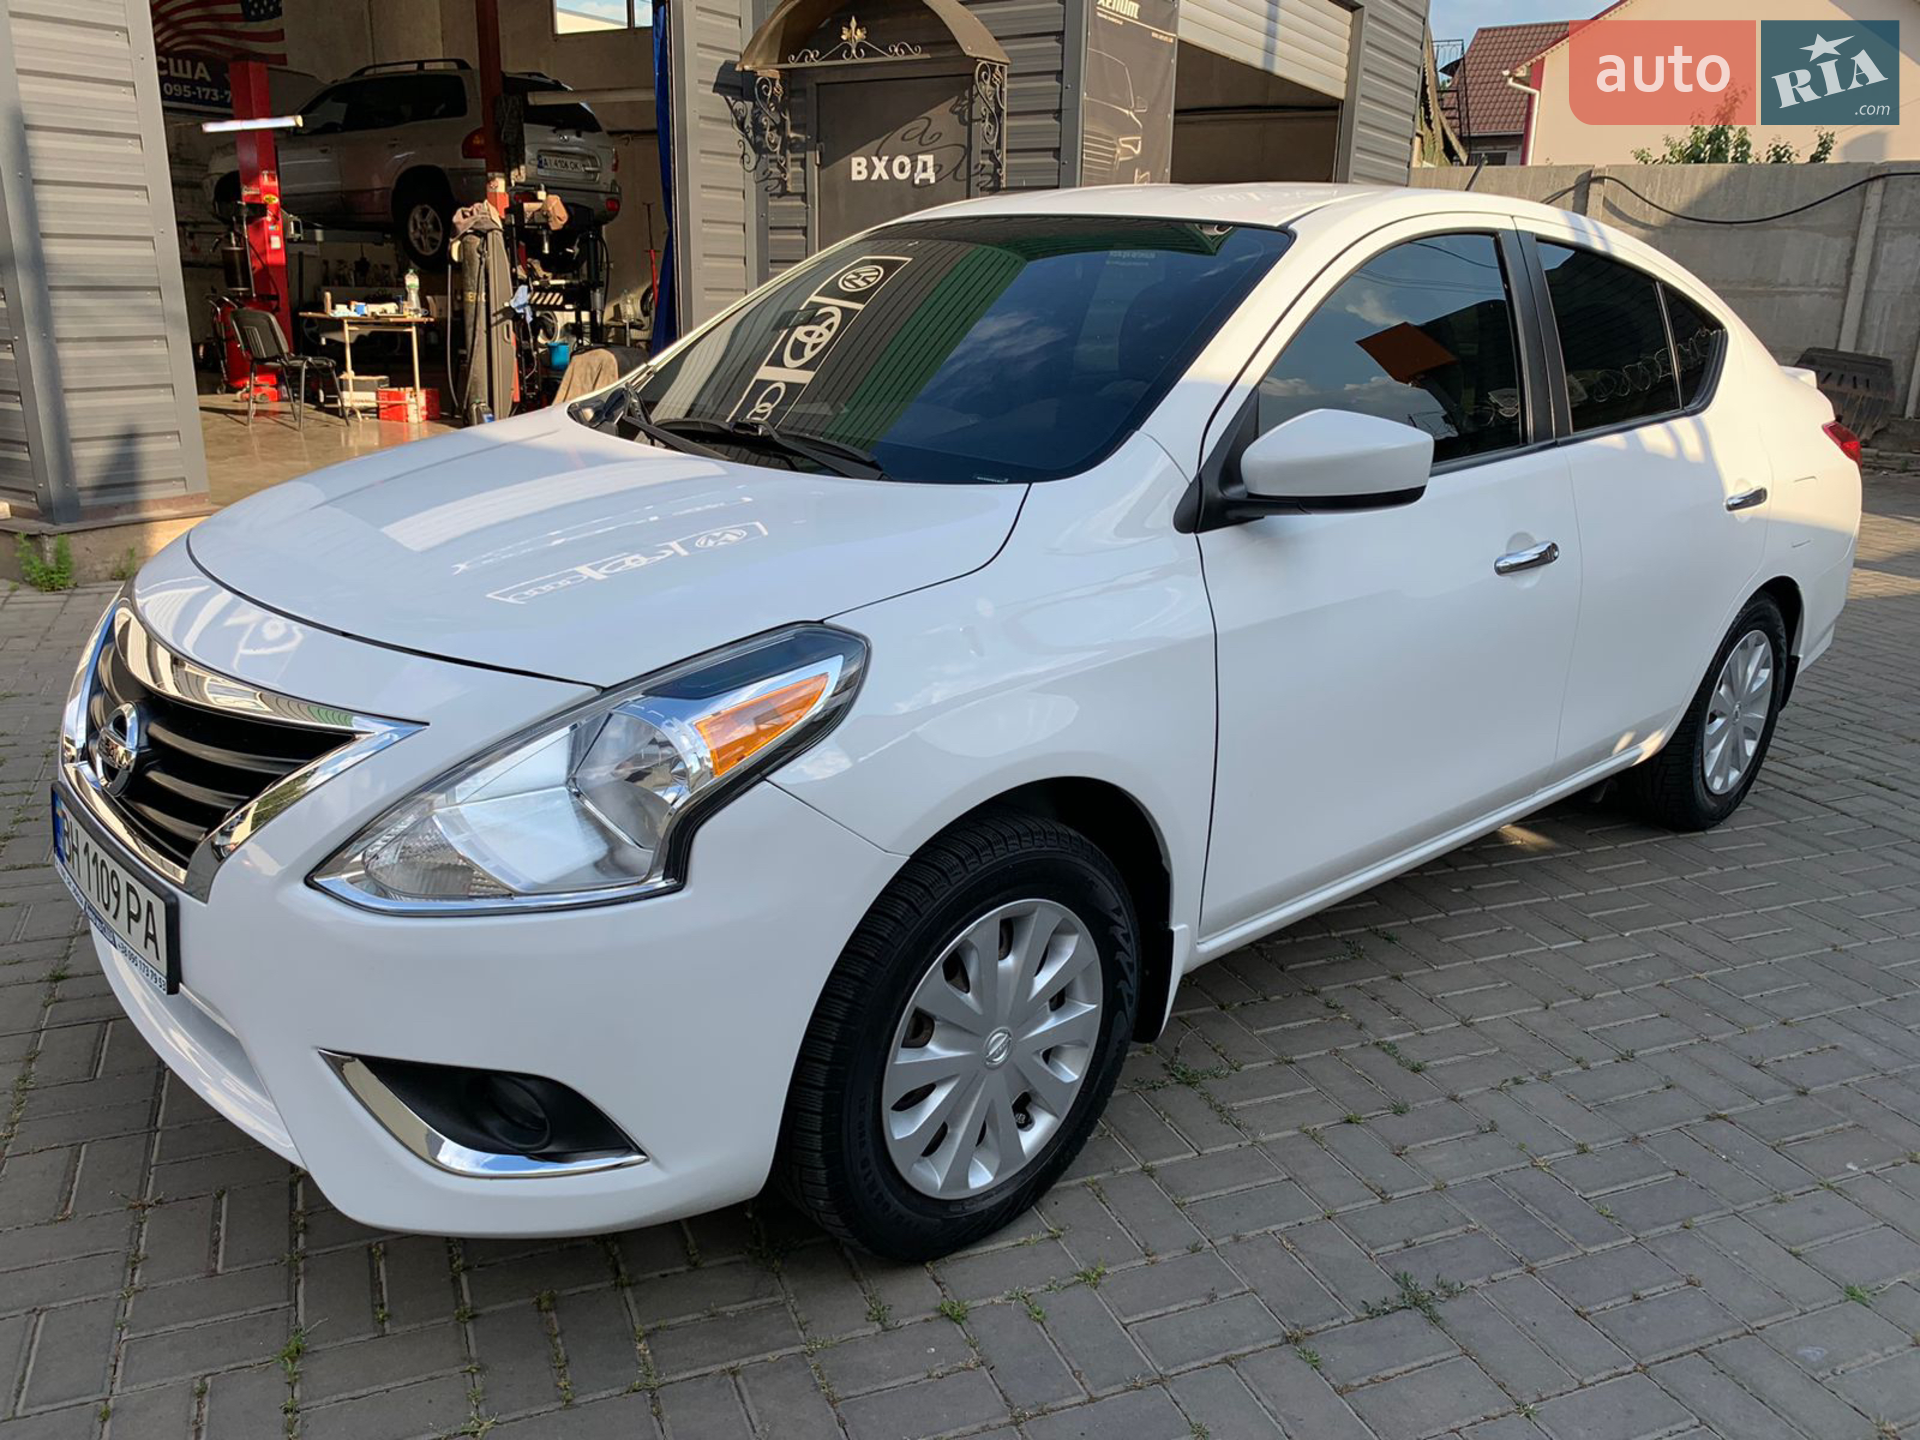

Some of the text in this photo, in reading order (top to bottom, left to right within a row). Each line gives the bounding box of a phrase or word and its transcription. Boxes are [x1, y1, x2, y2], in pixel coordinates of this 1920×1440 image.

[156, 55, 212, 82] США
[851, 154, 936, 185] ВХОД
[83, 841, 121, 921] 1109
[126, 881, 160, 961] PA
